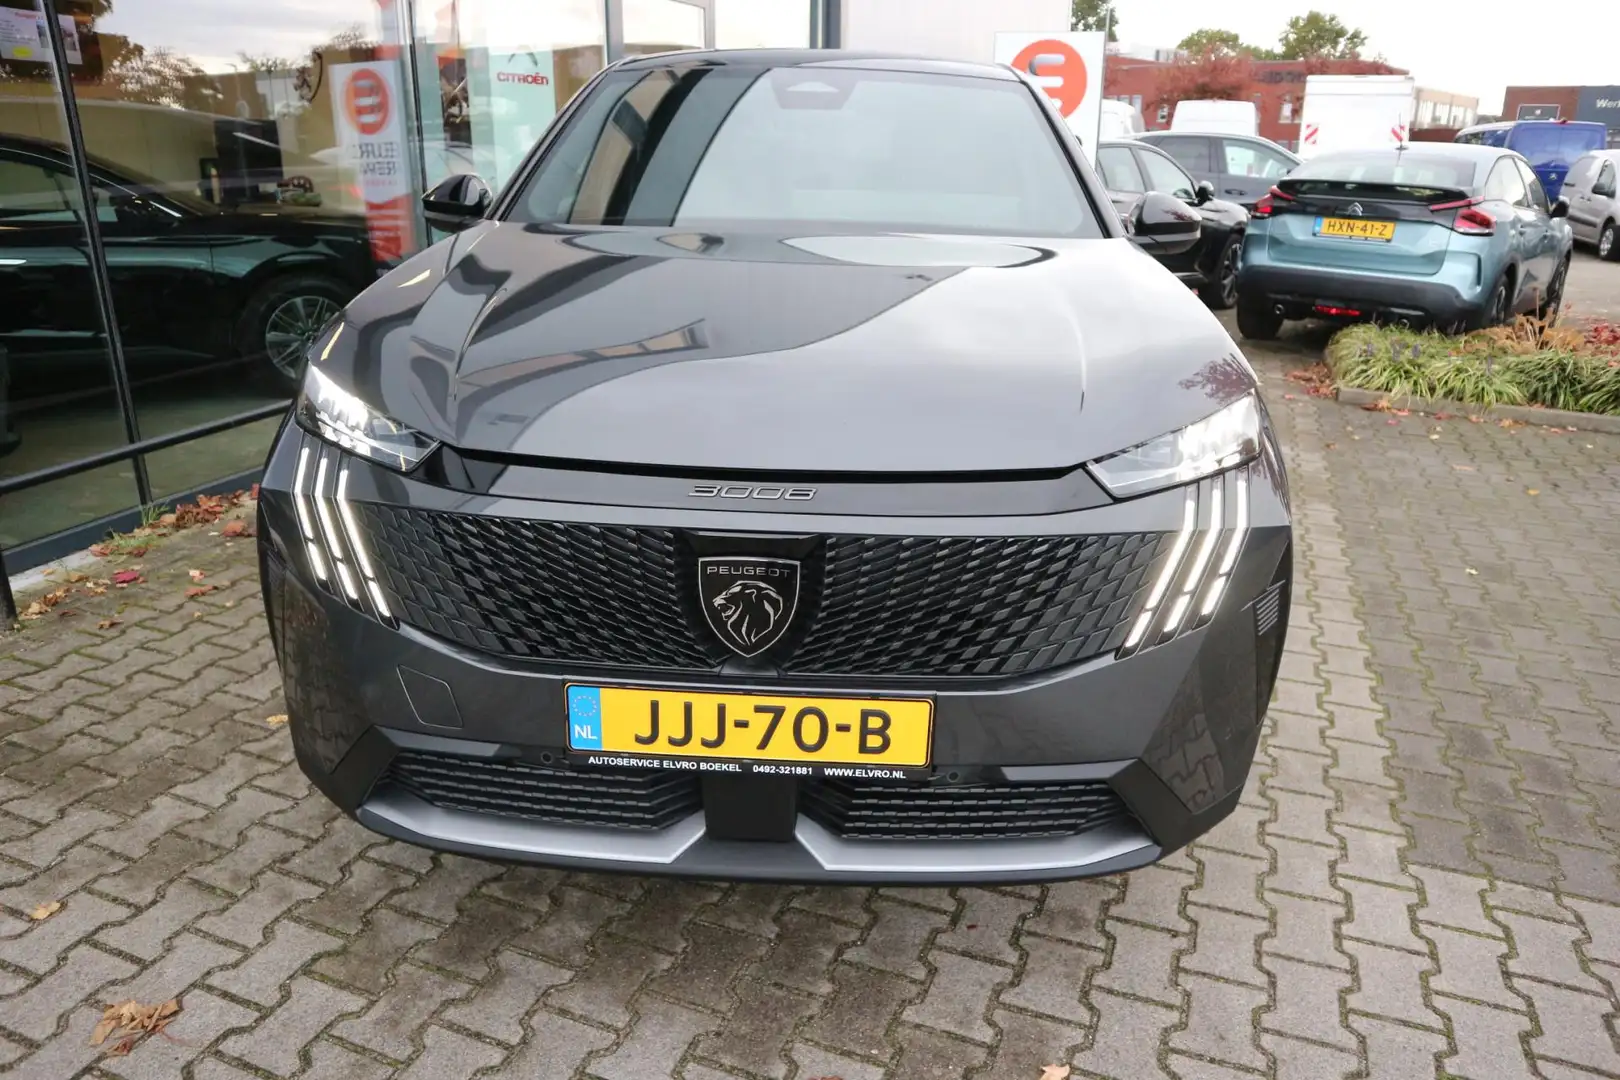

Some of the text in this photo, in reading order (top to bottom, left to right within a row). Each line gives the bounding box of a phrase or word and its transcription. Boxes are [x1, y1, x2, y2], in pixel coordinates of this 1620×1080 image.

[1327, 221, 1387, 236] HXN-41-Z
[688, 485, 818, 500] 3008
[706, 566, 791, 578] PEUGEOT
[574, 699, 892, 755] NL JJJ-70-B
[588, 756, 906, 779] AUTOSERVICE ELVRO BOEKEL 0492-321881 WWW.ELVRO.NL
